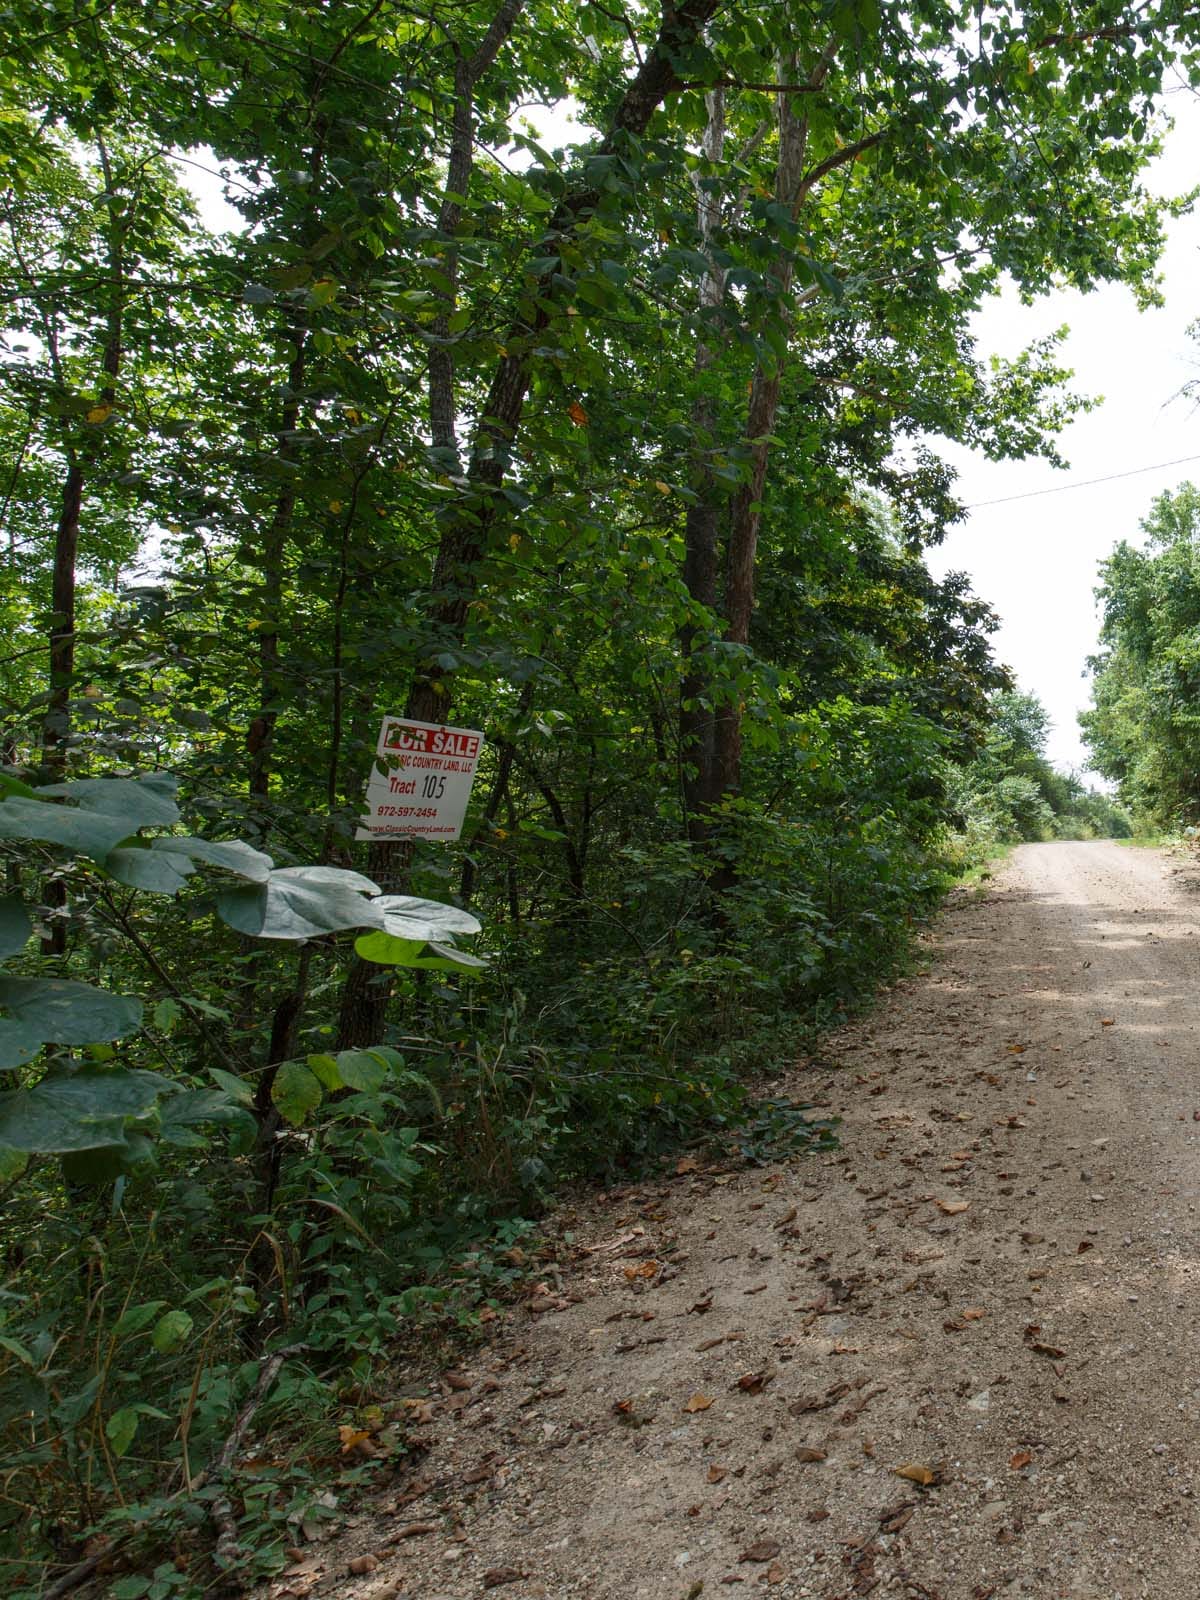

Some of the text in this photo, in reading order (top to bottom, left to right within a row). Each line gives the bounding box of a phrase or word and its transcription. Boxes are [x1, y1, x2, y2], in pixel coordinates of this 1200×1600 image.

[431, 732, 478, 756] SALE
[412, 756, 443, 770] COUNTRY
[443, 760, 460, 773] LAND,
[461, 761, 472, 773] LLC
[389, 775, 446, 799] Tract 105
[377, 806, 437, 818] 972-597-2454
